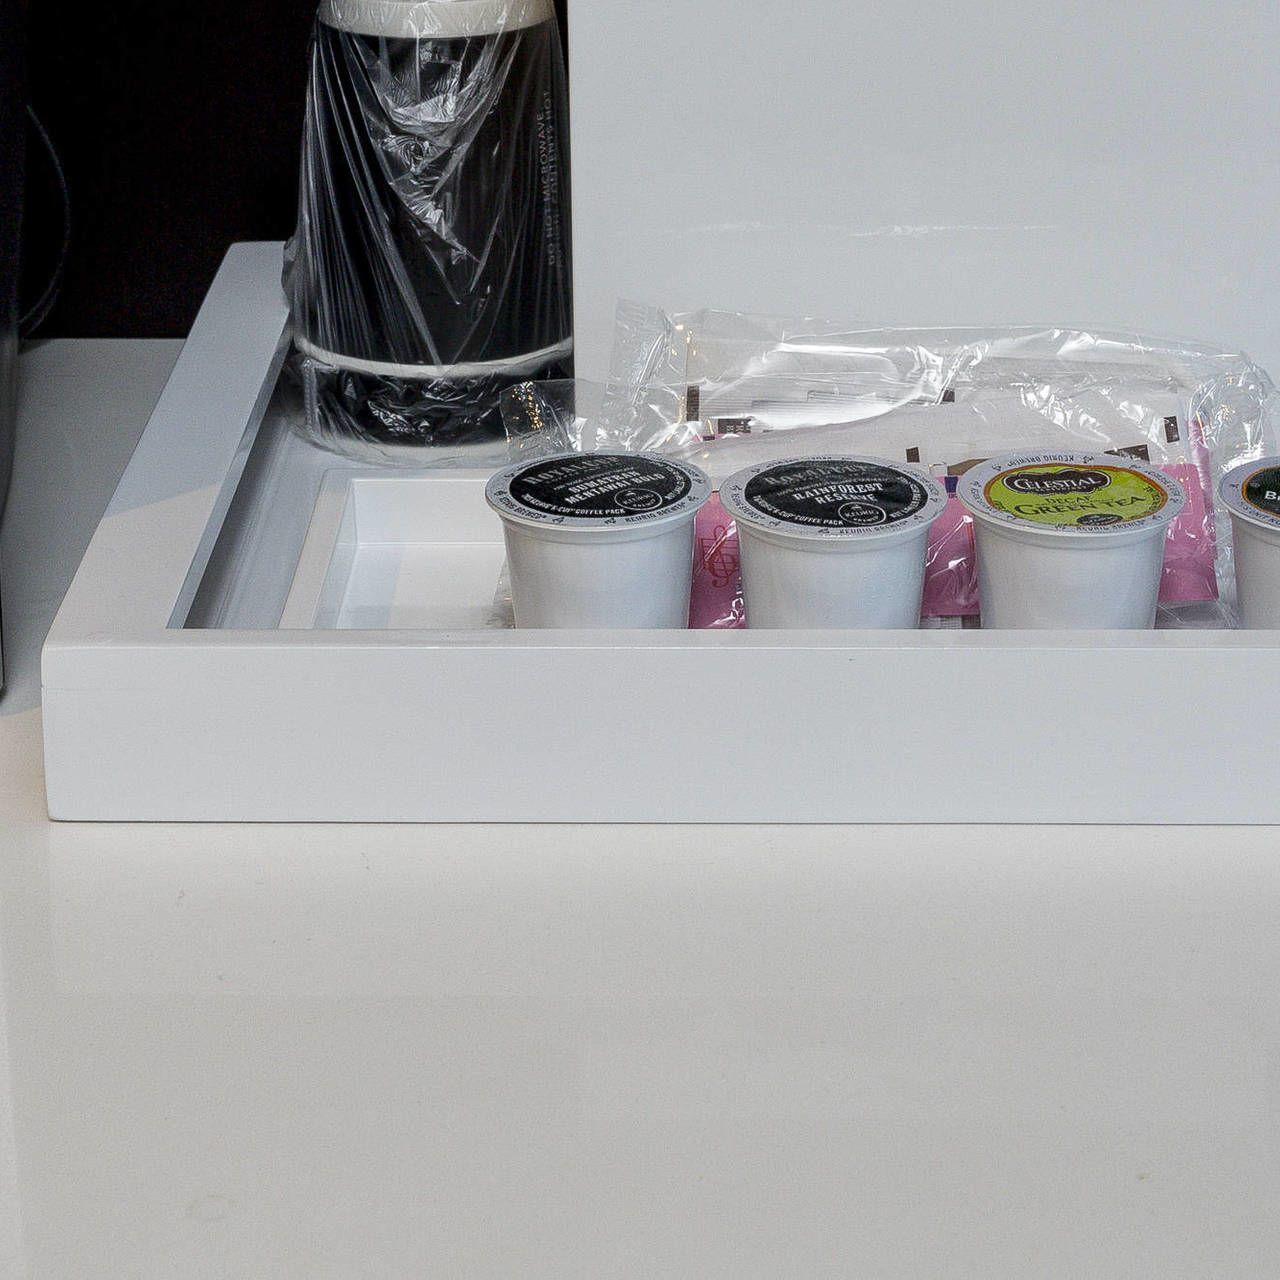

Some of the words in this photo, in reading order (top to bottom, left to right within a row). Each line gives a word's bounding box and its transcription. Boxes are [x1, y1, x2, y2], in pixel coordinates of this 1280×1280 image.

[1013, 477, 1102, 490] CELESTIAL
[1014, 502, 1097, 515] GREEN
[1101, 496, 1146, 507] TEA
